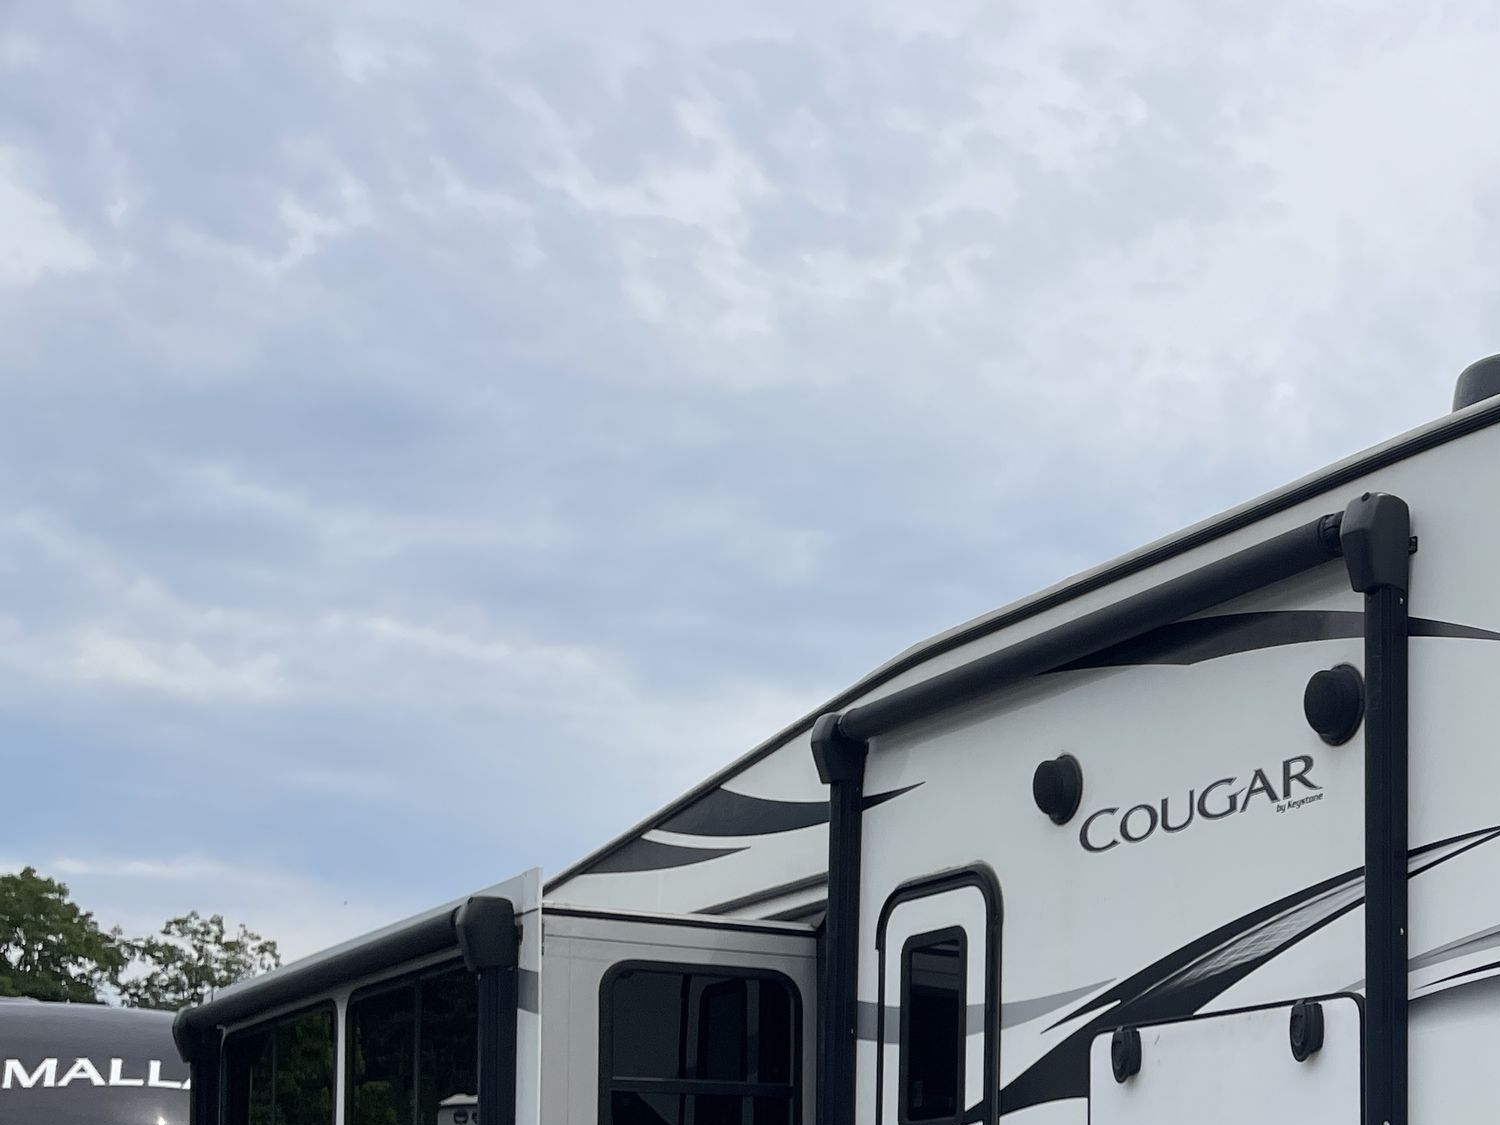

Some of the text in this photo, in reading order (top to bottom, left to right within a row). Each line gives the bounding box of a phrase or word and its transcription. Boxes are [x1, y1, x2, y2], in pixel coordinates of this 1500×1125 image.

[1079, 755, 1323, 853] COUGAR
[1276, 792, 1324, 813] by Keystone
